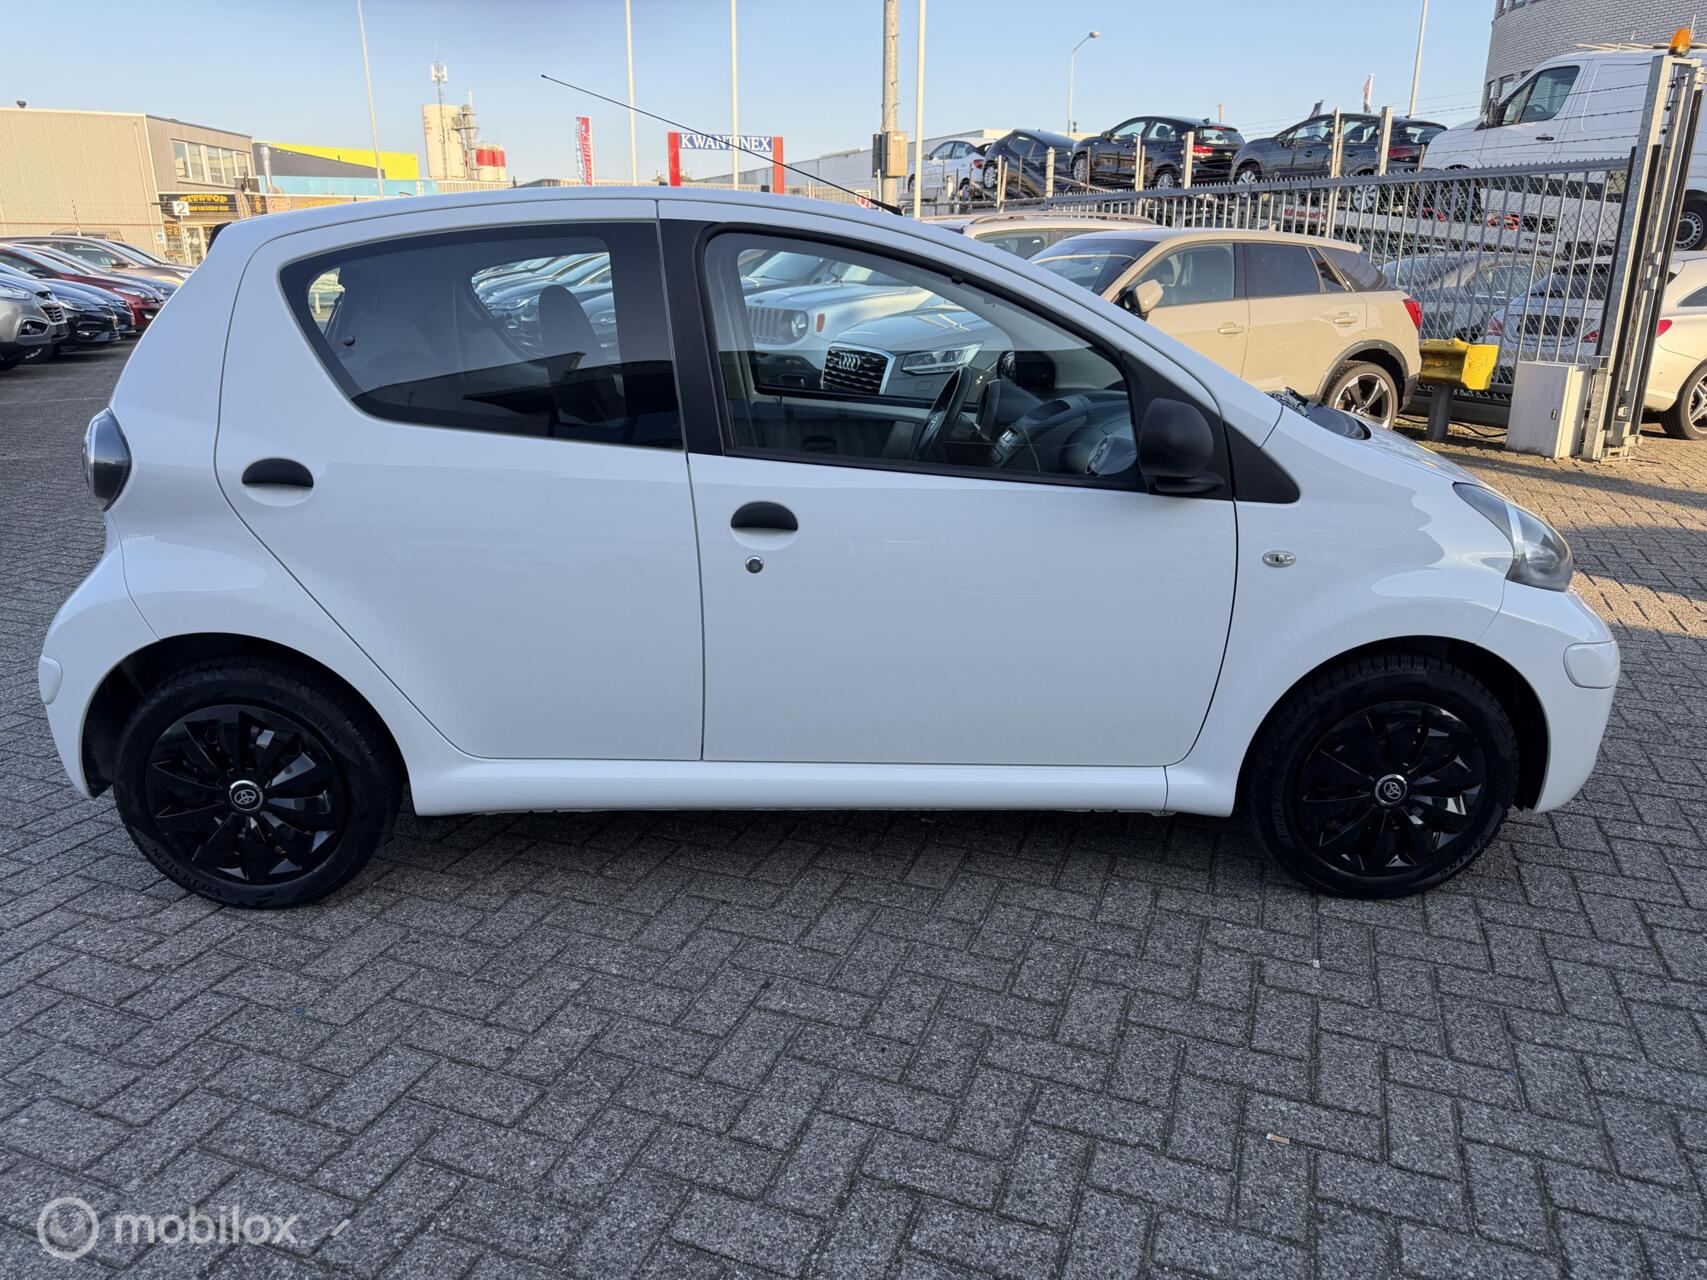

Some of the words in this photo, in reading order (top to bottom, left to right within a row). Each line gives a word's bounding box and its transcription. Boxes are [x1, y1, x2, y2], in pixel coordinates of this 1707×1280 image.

[680, 133, 771, 151] KWANTNEX
[176, 203, 187, 214] 2
[152, 847, 222, 897] VREDESTEIN
